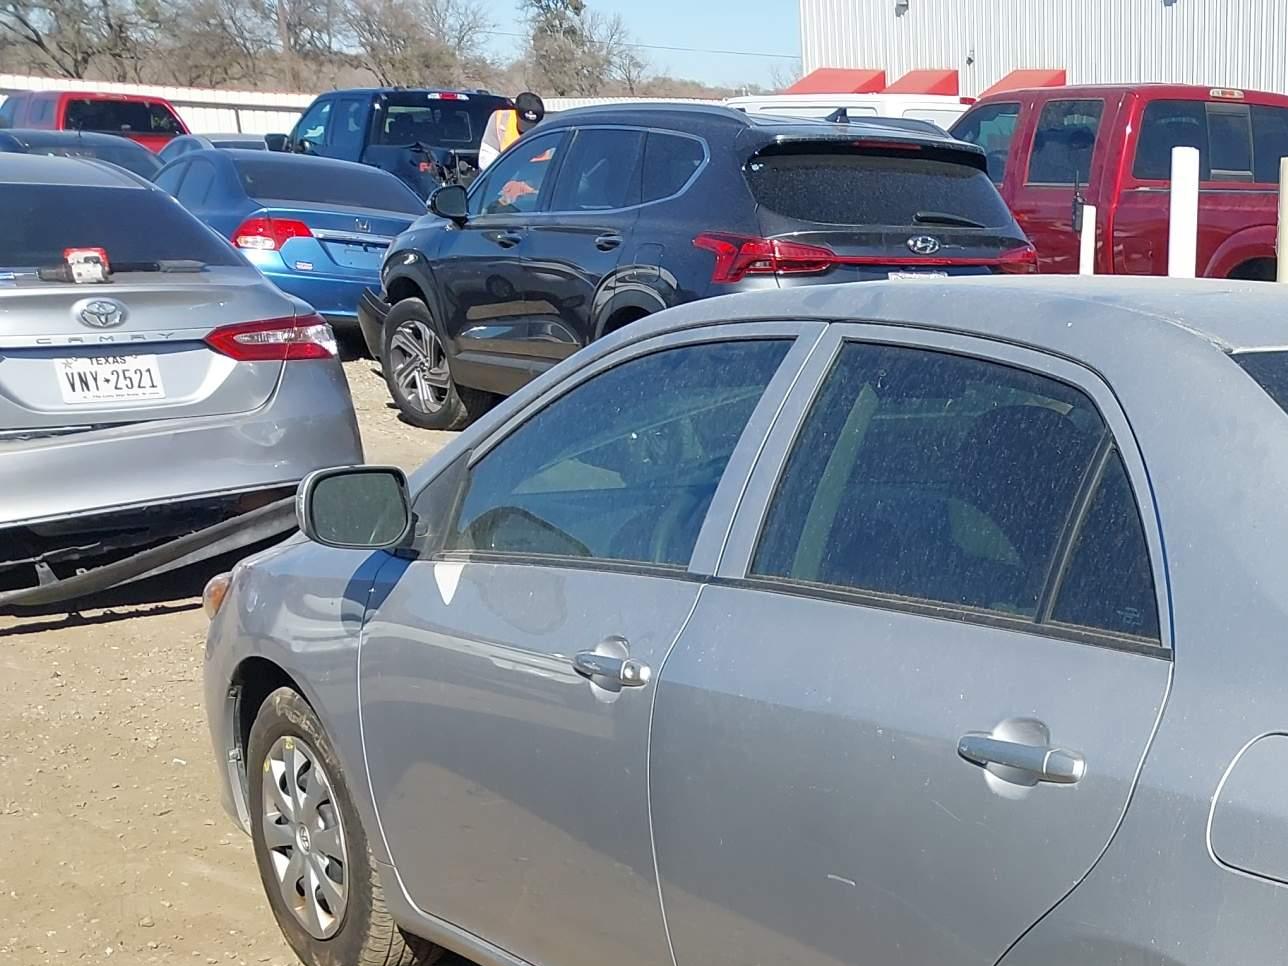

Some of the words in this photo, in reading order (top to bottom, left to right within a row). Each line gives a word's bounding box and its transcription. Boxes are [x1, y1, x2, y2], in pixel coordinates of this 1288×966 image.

[35, 332, 175, 345] CAMRY
[89, 356, 127, 366] TEXAS
[65, 370, 100, 393] VNY
[111, 367, 158, 391] 2521
